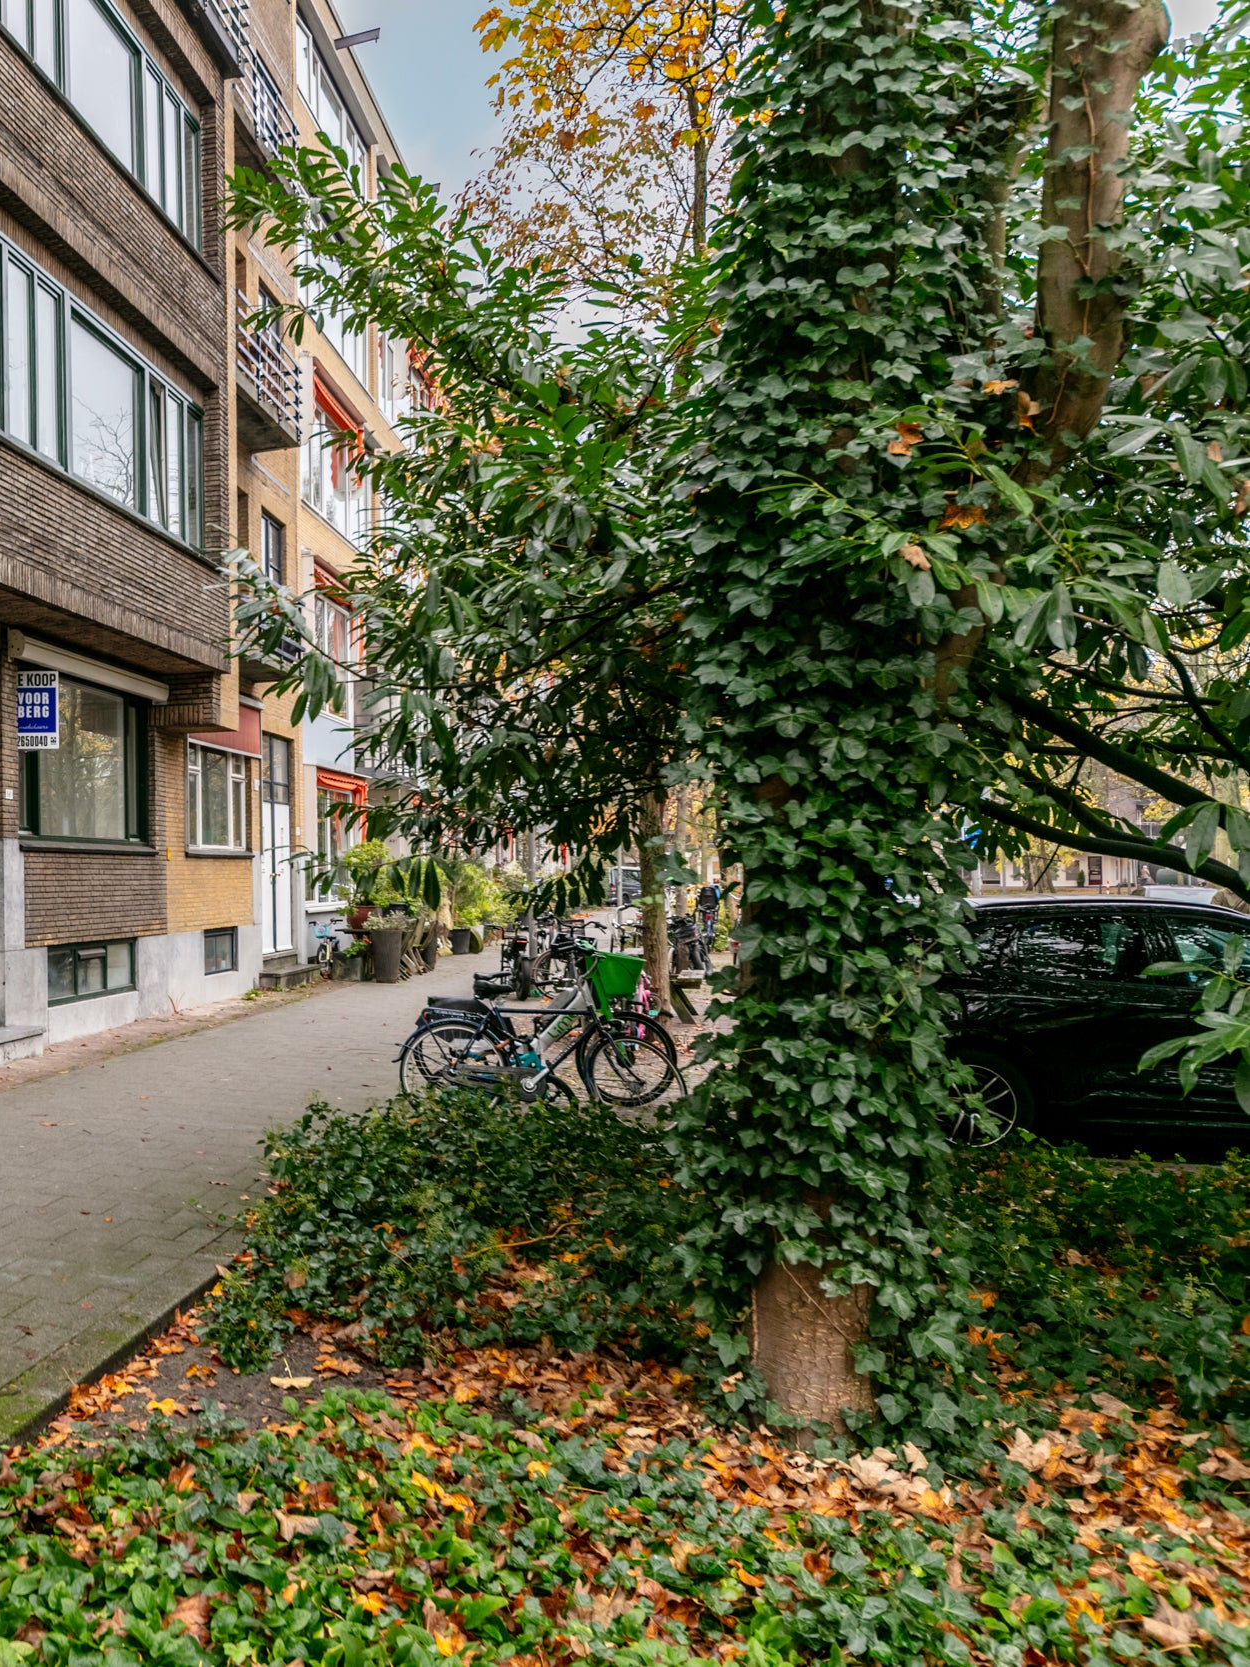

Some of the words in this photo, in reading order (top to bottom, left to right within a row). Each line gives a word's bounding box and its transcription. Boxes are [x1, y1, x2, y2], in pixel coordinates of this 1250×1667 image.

[27, 674, 56, 686] KOOP
[18, 692, 49, 704] VOOR
[18, 706, 49, 718] BERG
